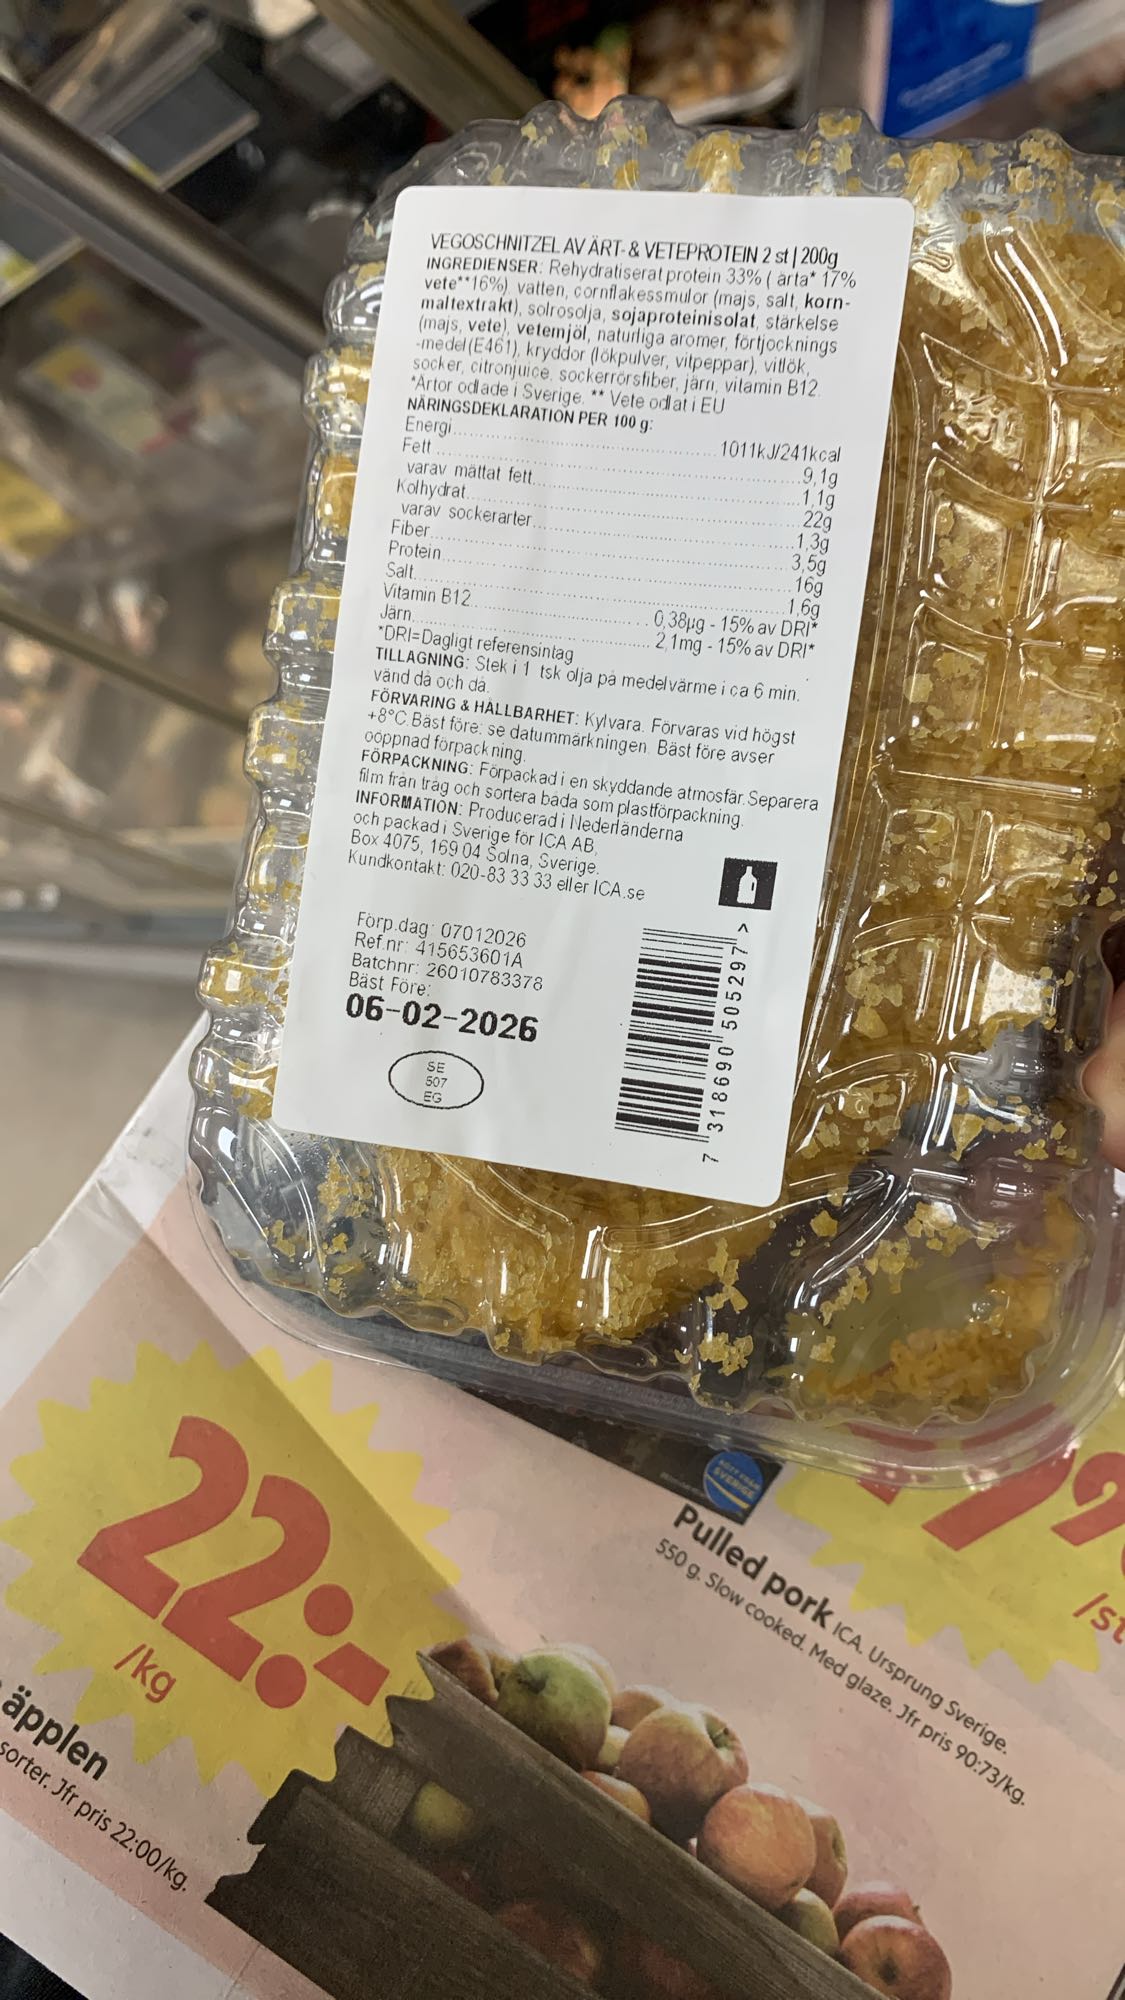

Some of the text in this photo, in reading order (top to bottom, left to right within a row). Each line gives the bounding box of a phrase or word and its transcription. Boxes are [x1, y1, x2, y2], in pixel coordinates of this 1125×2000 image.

[426, 257, 856, 288] INGREDIENSER: Rehydratiserat protein 33% 17%
[431, 233, 839, 270] VEGOSCHNITZEL AV & VETEPROTEIN 2 st 200g
[517, 281, 851, 311] vatten, cornflakessmulor (majs, salt, korn-
[527, 302, 839, 331] solrosolja, sojaproteinisolat, stärkelse
[517, 322, 838, 358] vetemjöl, naturliga aromer, förtjocknings
[526, 341, 809, 377] kryddor (lökpulver, vitpeppar), vitlök,
[458, 380, 726, 414] odlade Vete odlat EU
[559, 367, 782, 395] sockerrörsfiber, vitamin
[407, 397, 636, 429] NÄRINGSDEKLARATION PER 100
[402, 437, 838, 489] Fett 9,1g
[405, 416, 841, 463] Energi 1011kJ/241kcal
[396, 479, 832, 533] Kolhydrat 22g
[407, 462, 835, 511] varav mättat 1,1g
[391, 519, 826, 576] Fiber 3,5g
[400, 502, 829, 555] varav sockerarter 1,3g
[385, 561, 820, 621] Salt 1,6g
[388, 540, 823, 599] Protein 16g
[380, 604, 411, 621] Järn
[655, 632, 702, 656] 2,1mg
[718, 637, 751, 656] 15%
[754, 644, 773, 657] av
[383, 582, 436, 603] Vitamin
[441, 588, 472, 607] B12
[721, 615, 754, 634] 15%
[758, 622, 776, 635] av
[375, 646, 801, 702] TILLAGNING: Stek tsk olja medelvärme ca 6 min.
[476, 636, 574, 665] referensintag
[373, 669, 464, 690] vänd och
[370, 687, 796, 748] FÖRVARING & Förvaras vid högst
[411, 711, 775, 765] Bäst se Bäst före avser
[433, 736, 527, 765] förpackning.
[361, 748, 819, 811] FÖRPACKNING: Förpackad en skyddande Separera
[454, 781, 614, 813] och sortera som
[353, 811, 567, 850] och packad Sverige för ICA
[355, 789, 684, 842] INFORMATION: Producerad Nederländerna
[348, 849, 645, 901] Kundkontakt: 020-83 33 33 eller ICA.se
[351, 828, 600, 877] Box 4075, 169 04 Solna, Sverige.
[416, 940, 523, 969] 415653601A
[441, 922, 527, 948] 07012026
[349, 971, 431, 997] Bäst Före:
[352, 952, 543, 992] Batchnr: 26010783378
[346, 993, 540, 1042] 06-02-2026
[707, 945, 748, 1133] 318690 505297
[425, 1076, 448, 1088] 507
[427, 1061, 446, 1074] SE
[423, 1091, 443, 1104] EG
[673, 1502, 1009, 1756] Pulled pork ICA. Ursprung Sverige.
[114, 1642, 177, 1705] /kg
[655, 1537, 1027, 1806] 550 g. Slow cooked. Med glaze. Jfr pris 90:73/kg.
[1, 1685, 108, 1781] äpplen
[51, 1778, 79, 1806] Jfr
[74, 1800, 112, 1832] pris
[110, 1821, 188, 1891] 22:00/kg.
